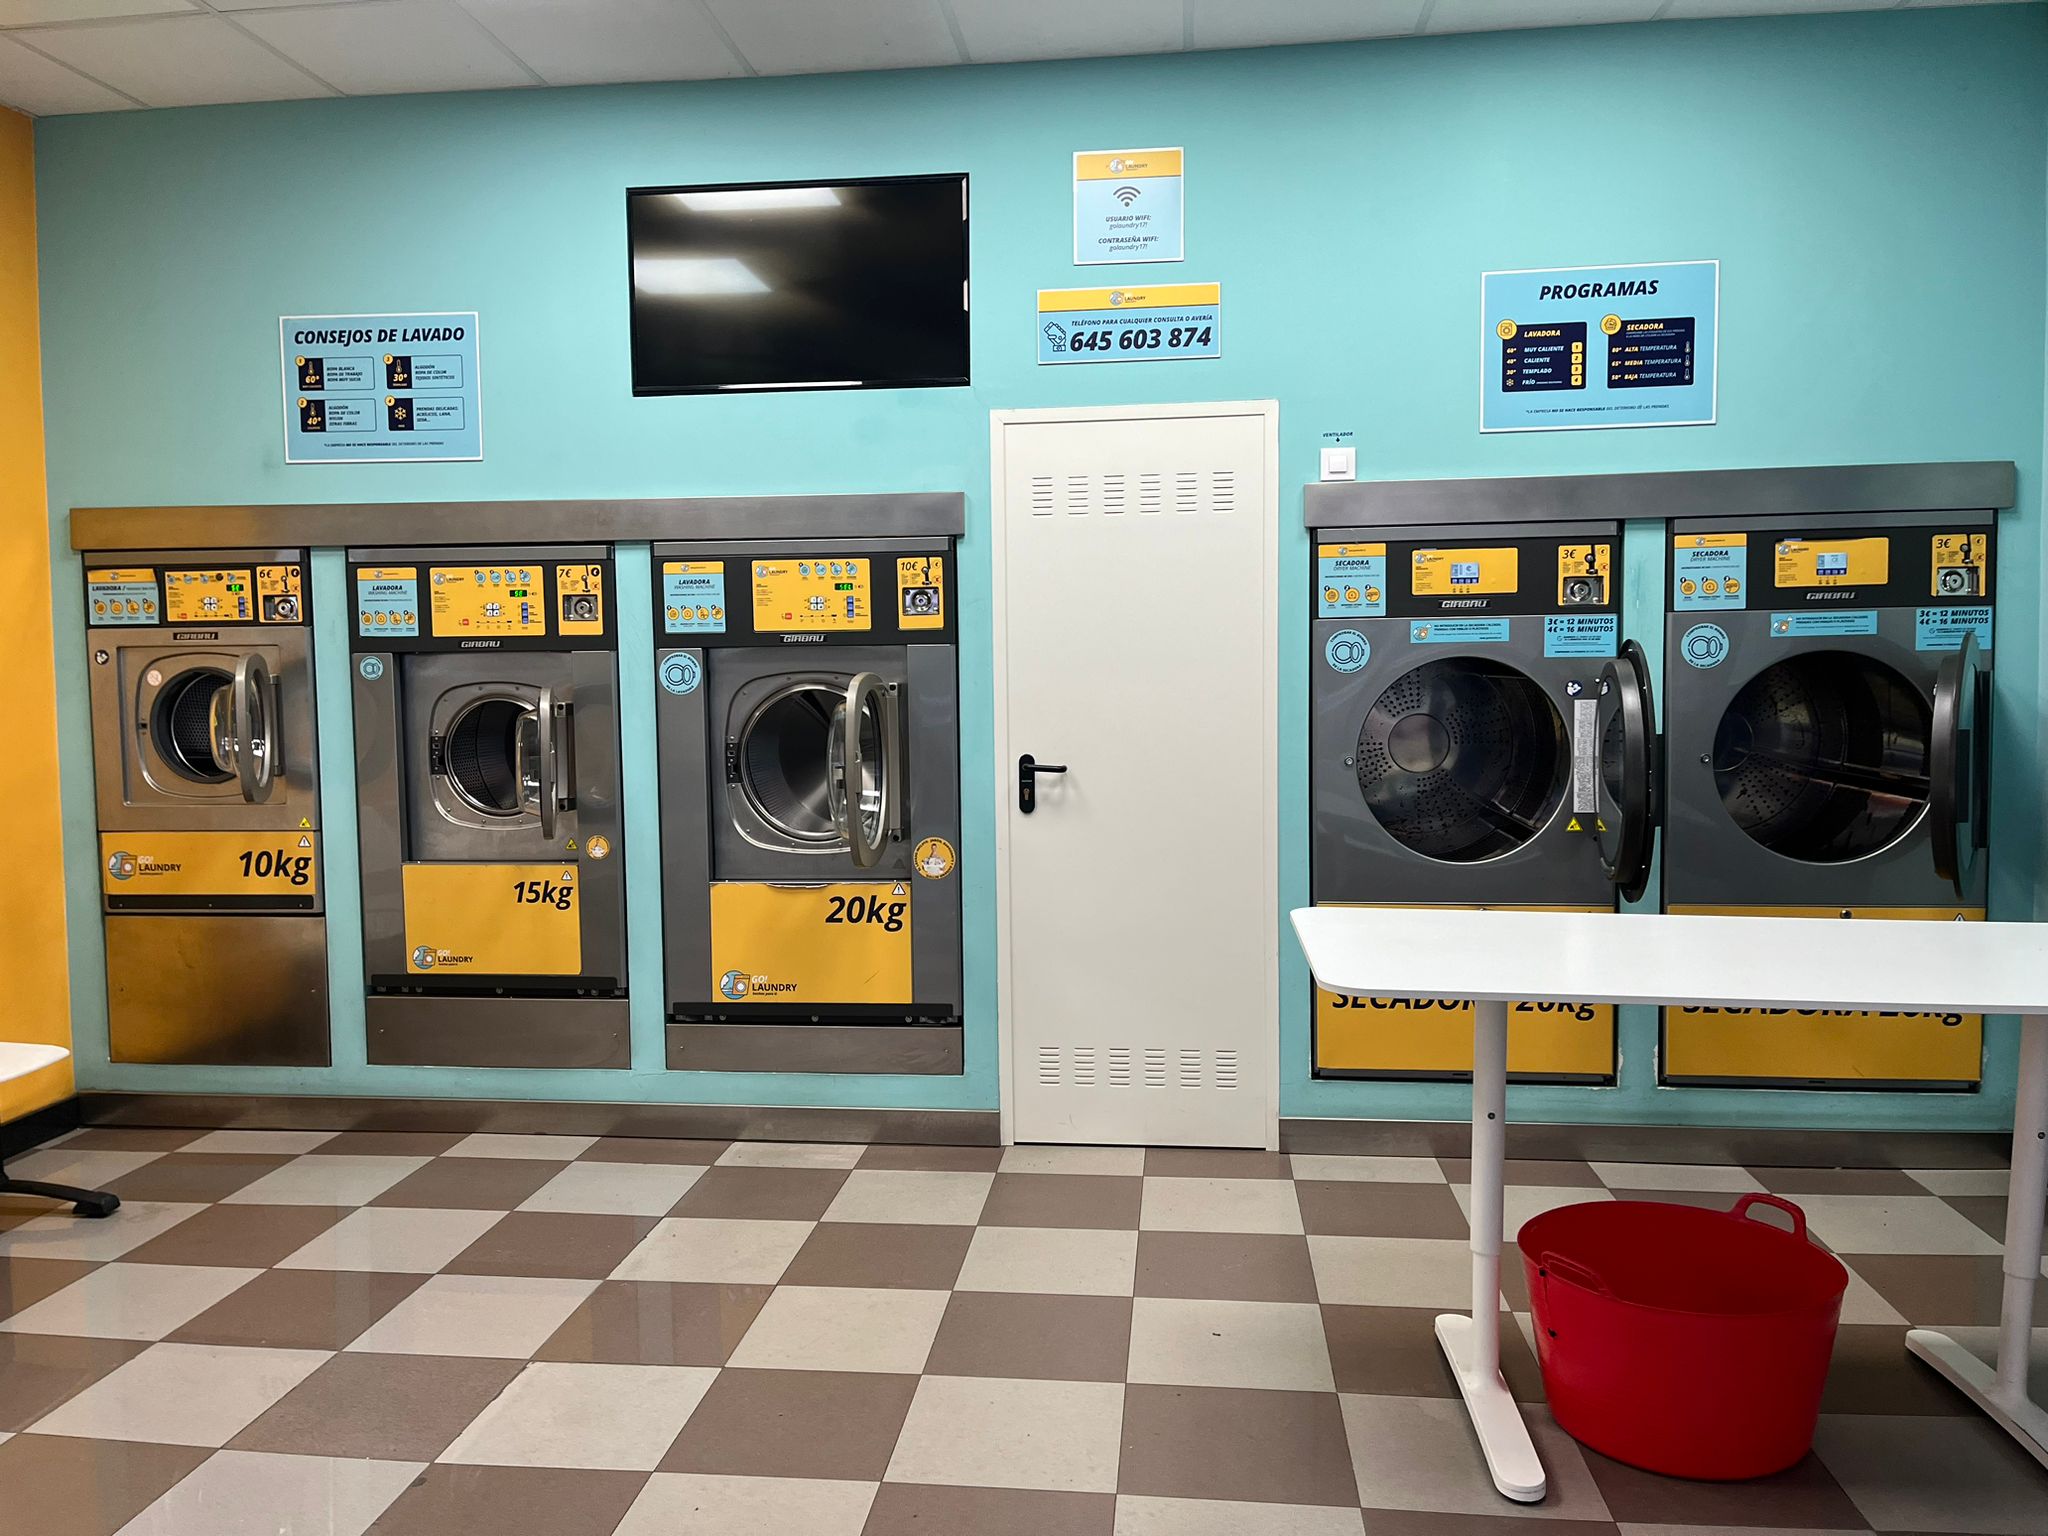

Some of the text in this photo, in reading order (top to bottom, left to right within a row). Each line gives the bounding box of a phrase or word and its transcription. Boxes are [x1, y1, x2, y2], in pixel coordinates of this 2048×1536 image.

[1098, 235, 1141, 244] CONTRASEÑA
[1539, 280, 1659, 300] PROGRAMAS
[1071, 319, 1101, 327] TELÉFONO
[1119, 317, 1153, 325] CUALQUIER
[1626, 323, 1664, 331] SECADORA
[294, 327, 465, 347] CONSEJOS DE LAVADO
[1524, 329, 1561, 338] LAVADORA
[1070, 326, 1212, 352] 645 603 874
[305, 375, 320, 384] 60°
[393, 373, 408, 382] 30°
[307, 417, 322, 425] 40°
[1936, 538, 1951, 549] 3€
[1562, 549, 1577, 559] 3€
[900, 561, 918, 571] 10€
[559, 568, 572, 578] 7€
[783, 634, 825, 643] GIRBAU
[138, 863, 182, 872] LAUNDRY
[239, 849, 313, 885] 10kg
[513, 881, 574, 910] 15kg
[825, 895, 907, 932] 20kg
[751, 975, 768, 984] GO!
[752, 984, 798, 992] LAUNDRY
